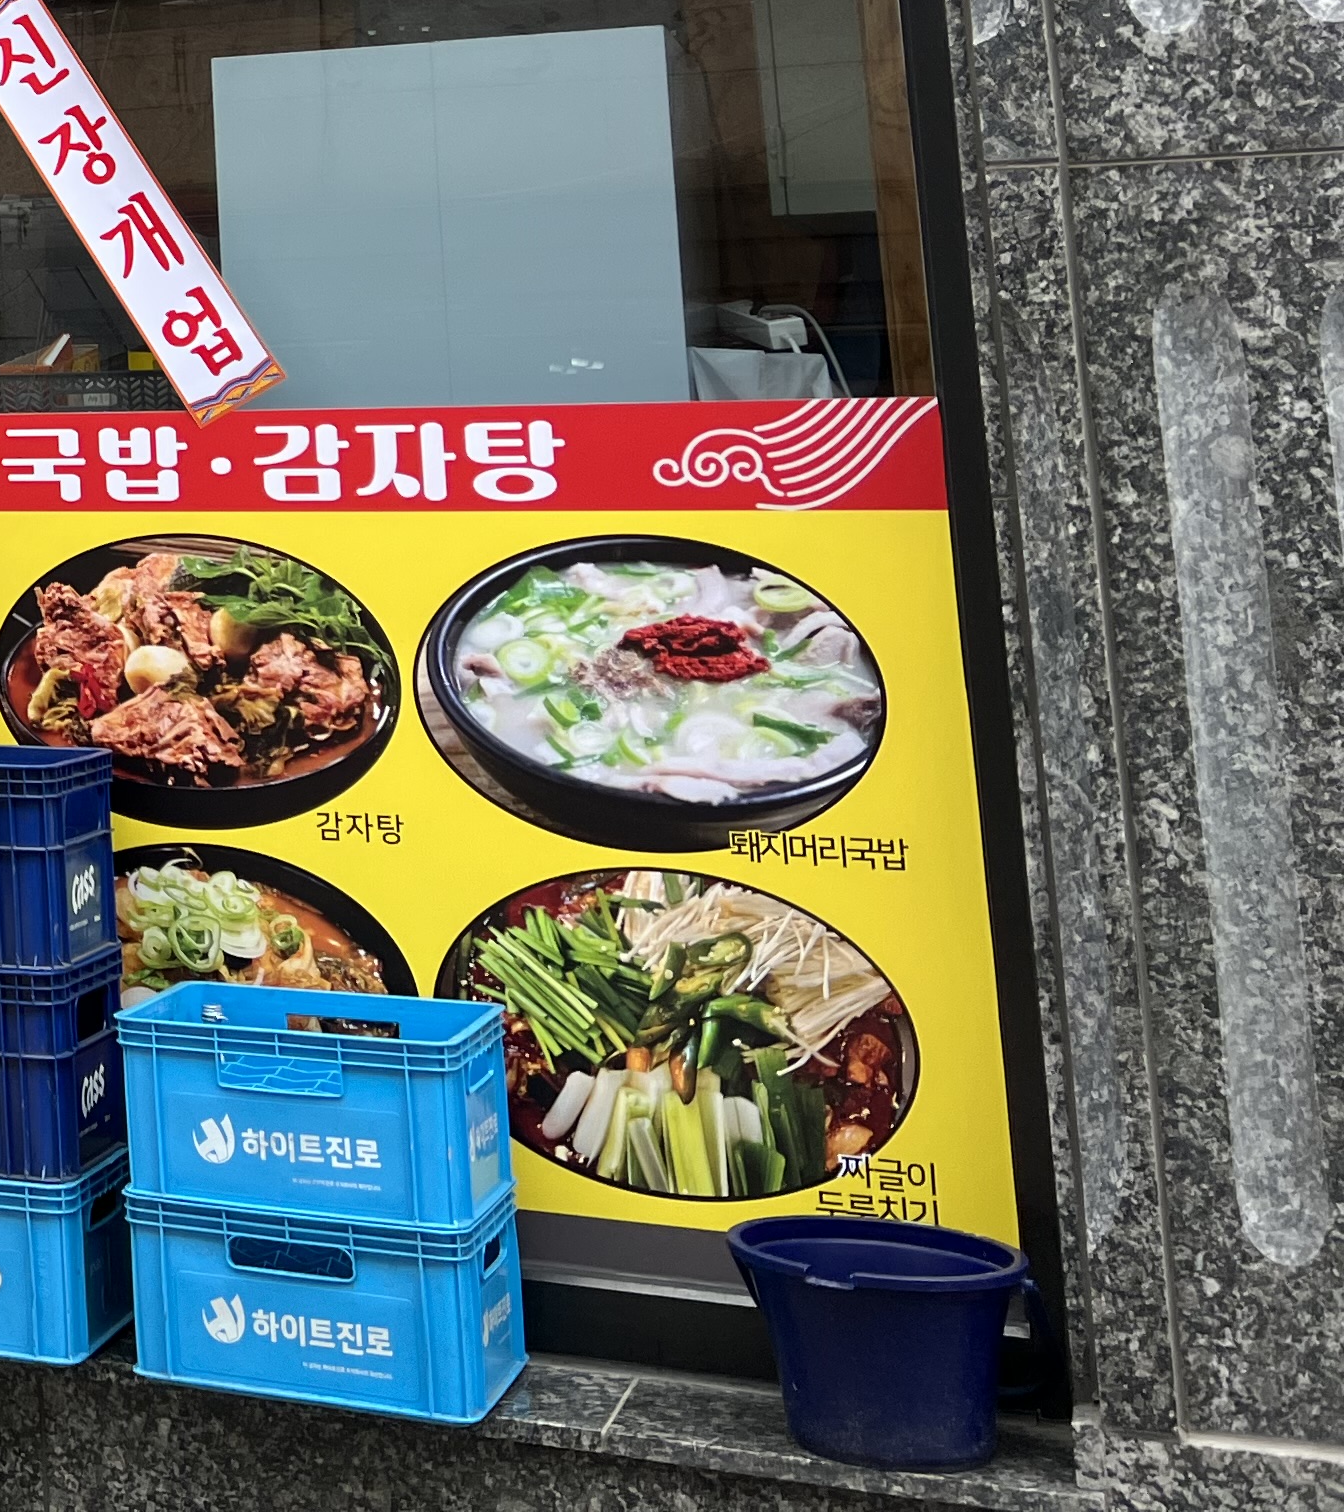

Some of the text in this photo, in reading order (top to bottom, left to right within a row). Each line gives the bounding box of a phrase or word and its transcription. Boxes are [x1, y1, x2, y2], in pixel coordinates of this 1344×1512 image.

[315, 810, 406, 846] 감자탕
[728, 829, 910, 872] 돼지머리국밥
[240, 1126, 382, 1170] 하이트진로
[838, 1154, 938, 1196] 짜글이
[251, 1307, 395, 1358] 하이트진로
